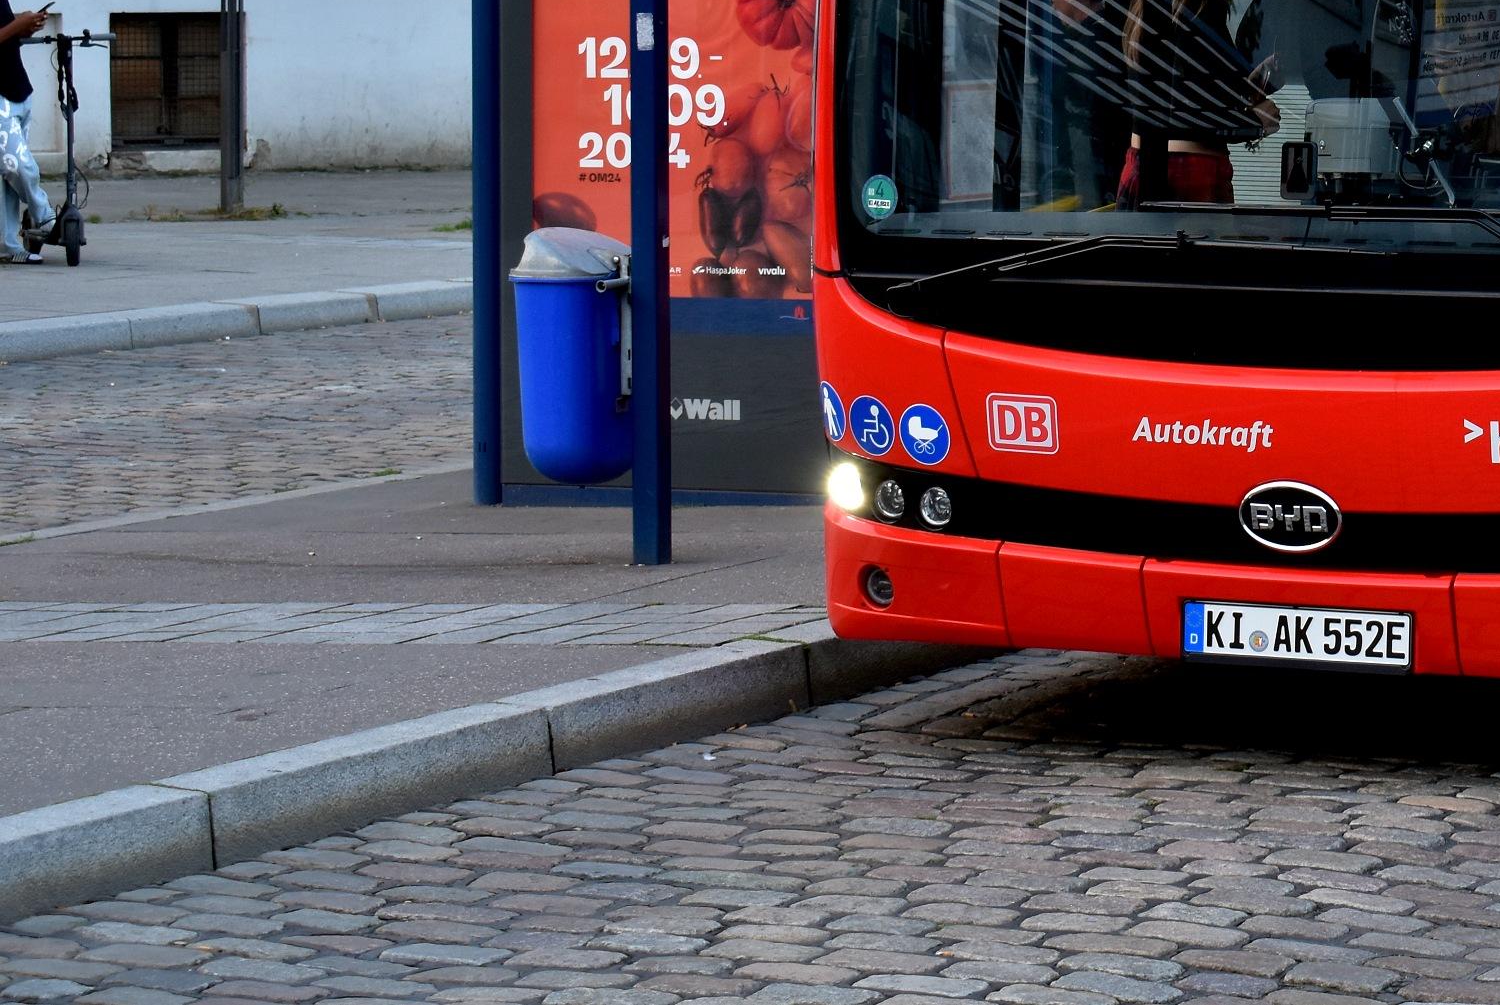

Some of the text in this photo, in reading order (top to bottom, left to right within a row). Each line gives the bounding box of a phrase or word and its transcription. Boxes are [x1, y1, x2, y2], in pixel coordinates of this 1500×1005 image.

[875, 181, 884, 197] 4
[669, 267, 682, 275] AR
[758, 265, 786, 276] vivalu
[683, 399, 741, 421] Wall
[993, 399, 1053, 449] DB
[1132, 416, 1274, 453] Autokraft
[1249, 502, 1329, 534] BYD
[1189, 610, 1406, 660] D KI AK 552E
